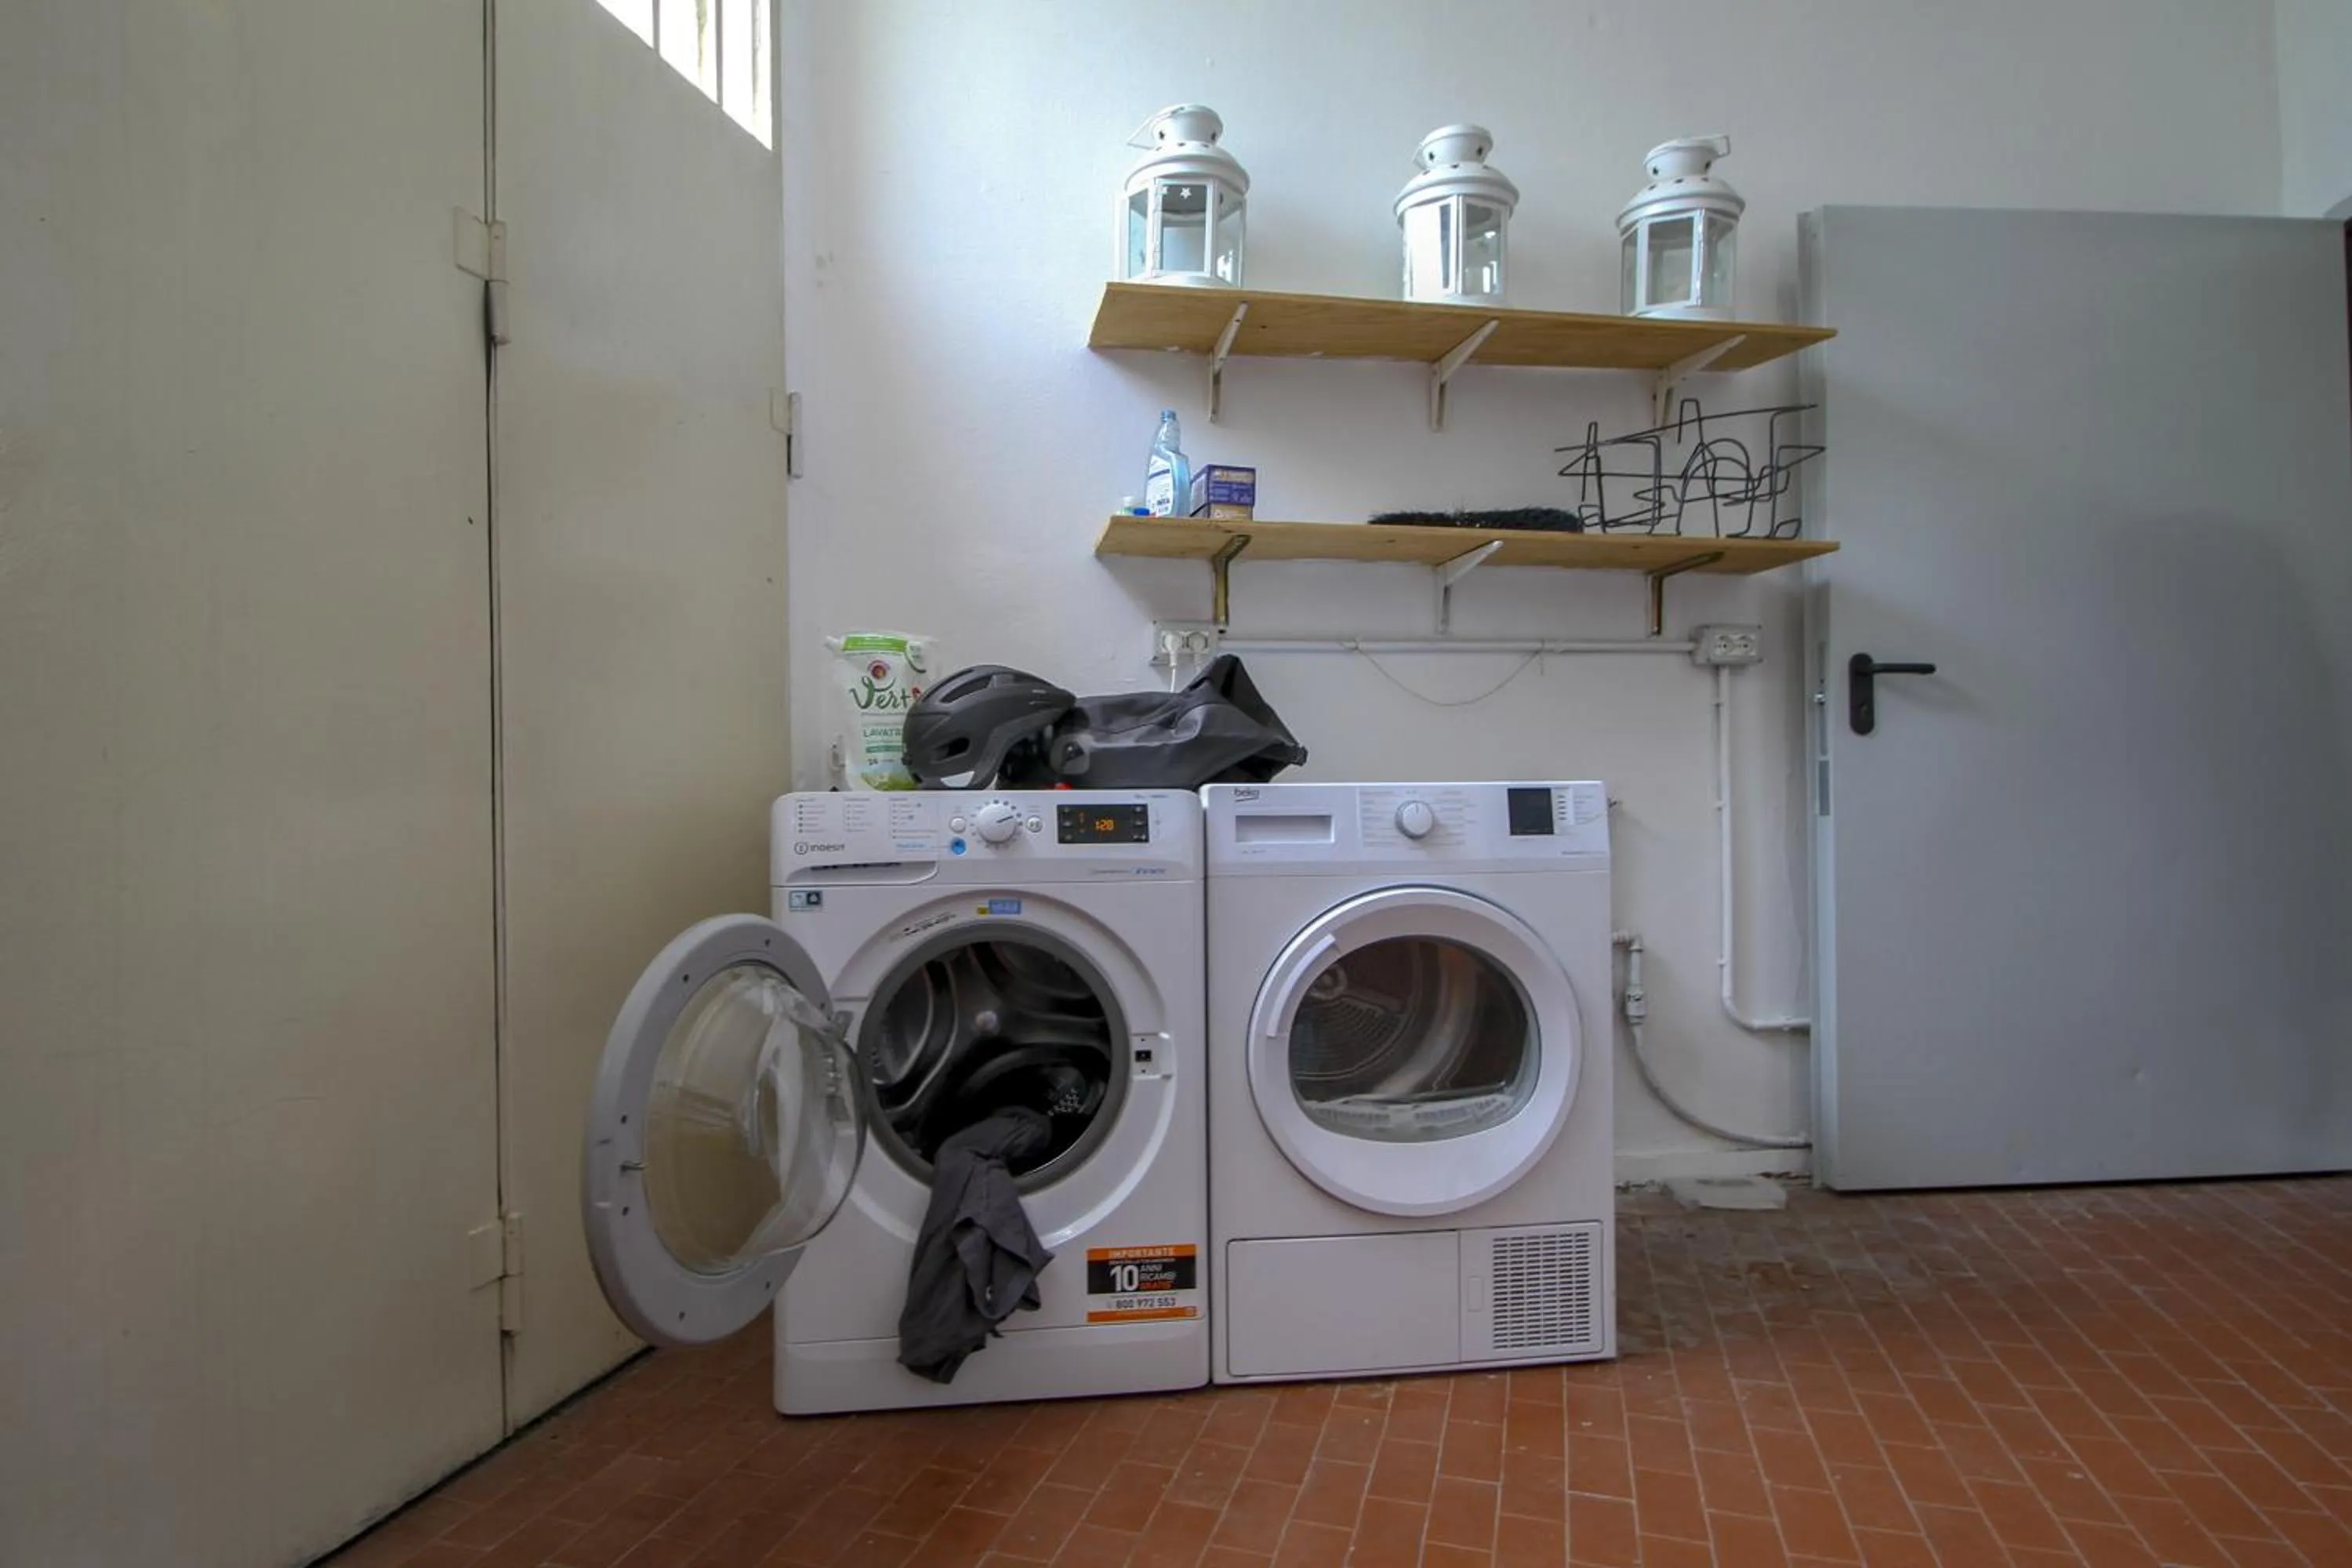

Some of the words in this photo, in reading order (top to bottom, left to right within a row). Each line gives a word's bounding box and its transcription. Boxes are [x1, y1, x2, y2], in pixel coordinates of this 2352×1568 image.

[863, 728, 903, 737] LAVATR
[1109, 1247, 1175, 1259] IMPORTANTE
[1109, 1265, 1139, 1292] 10
